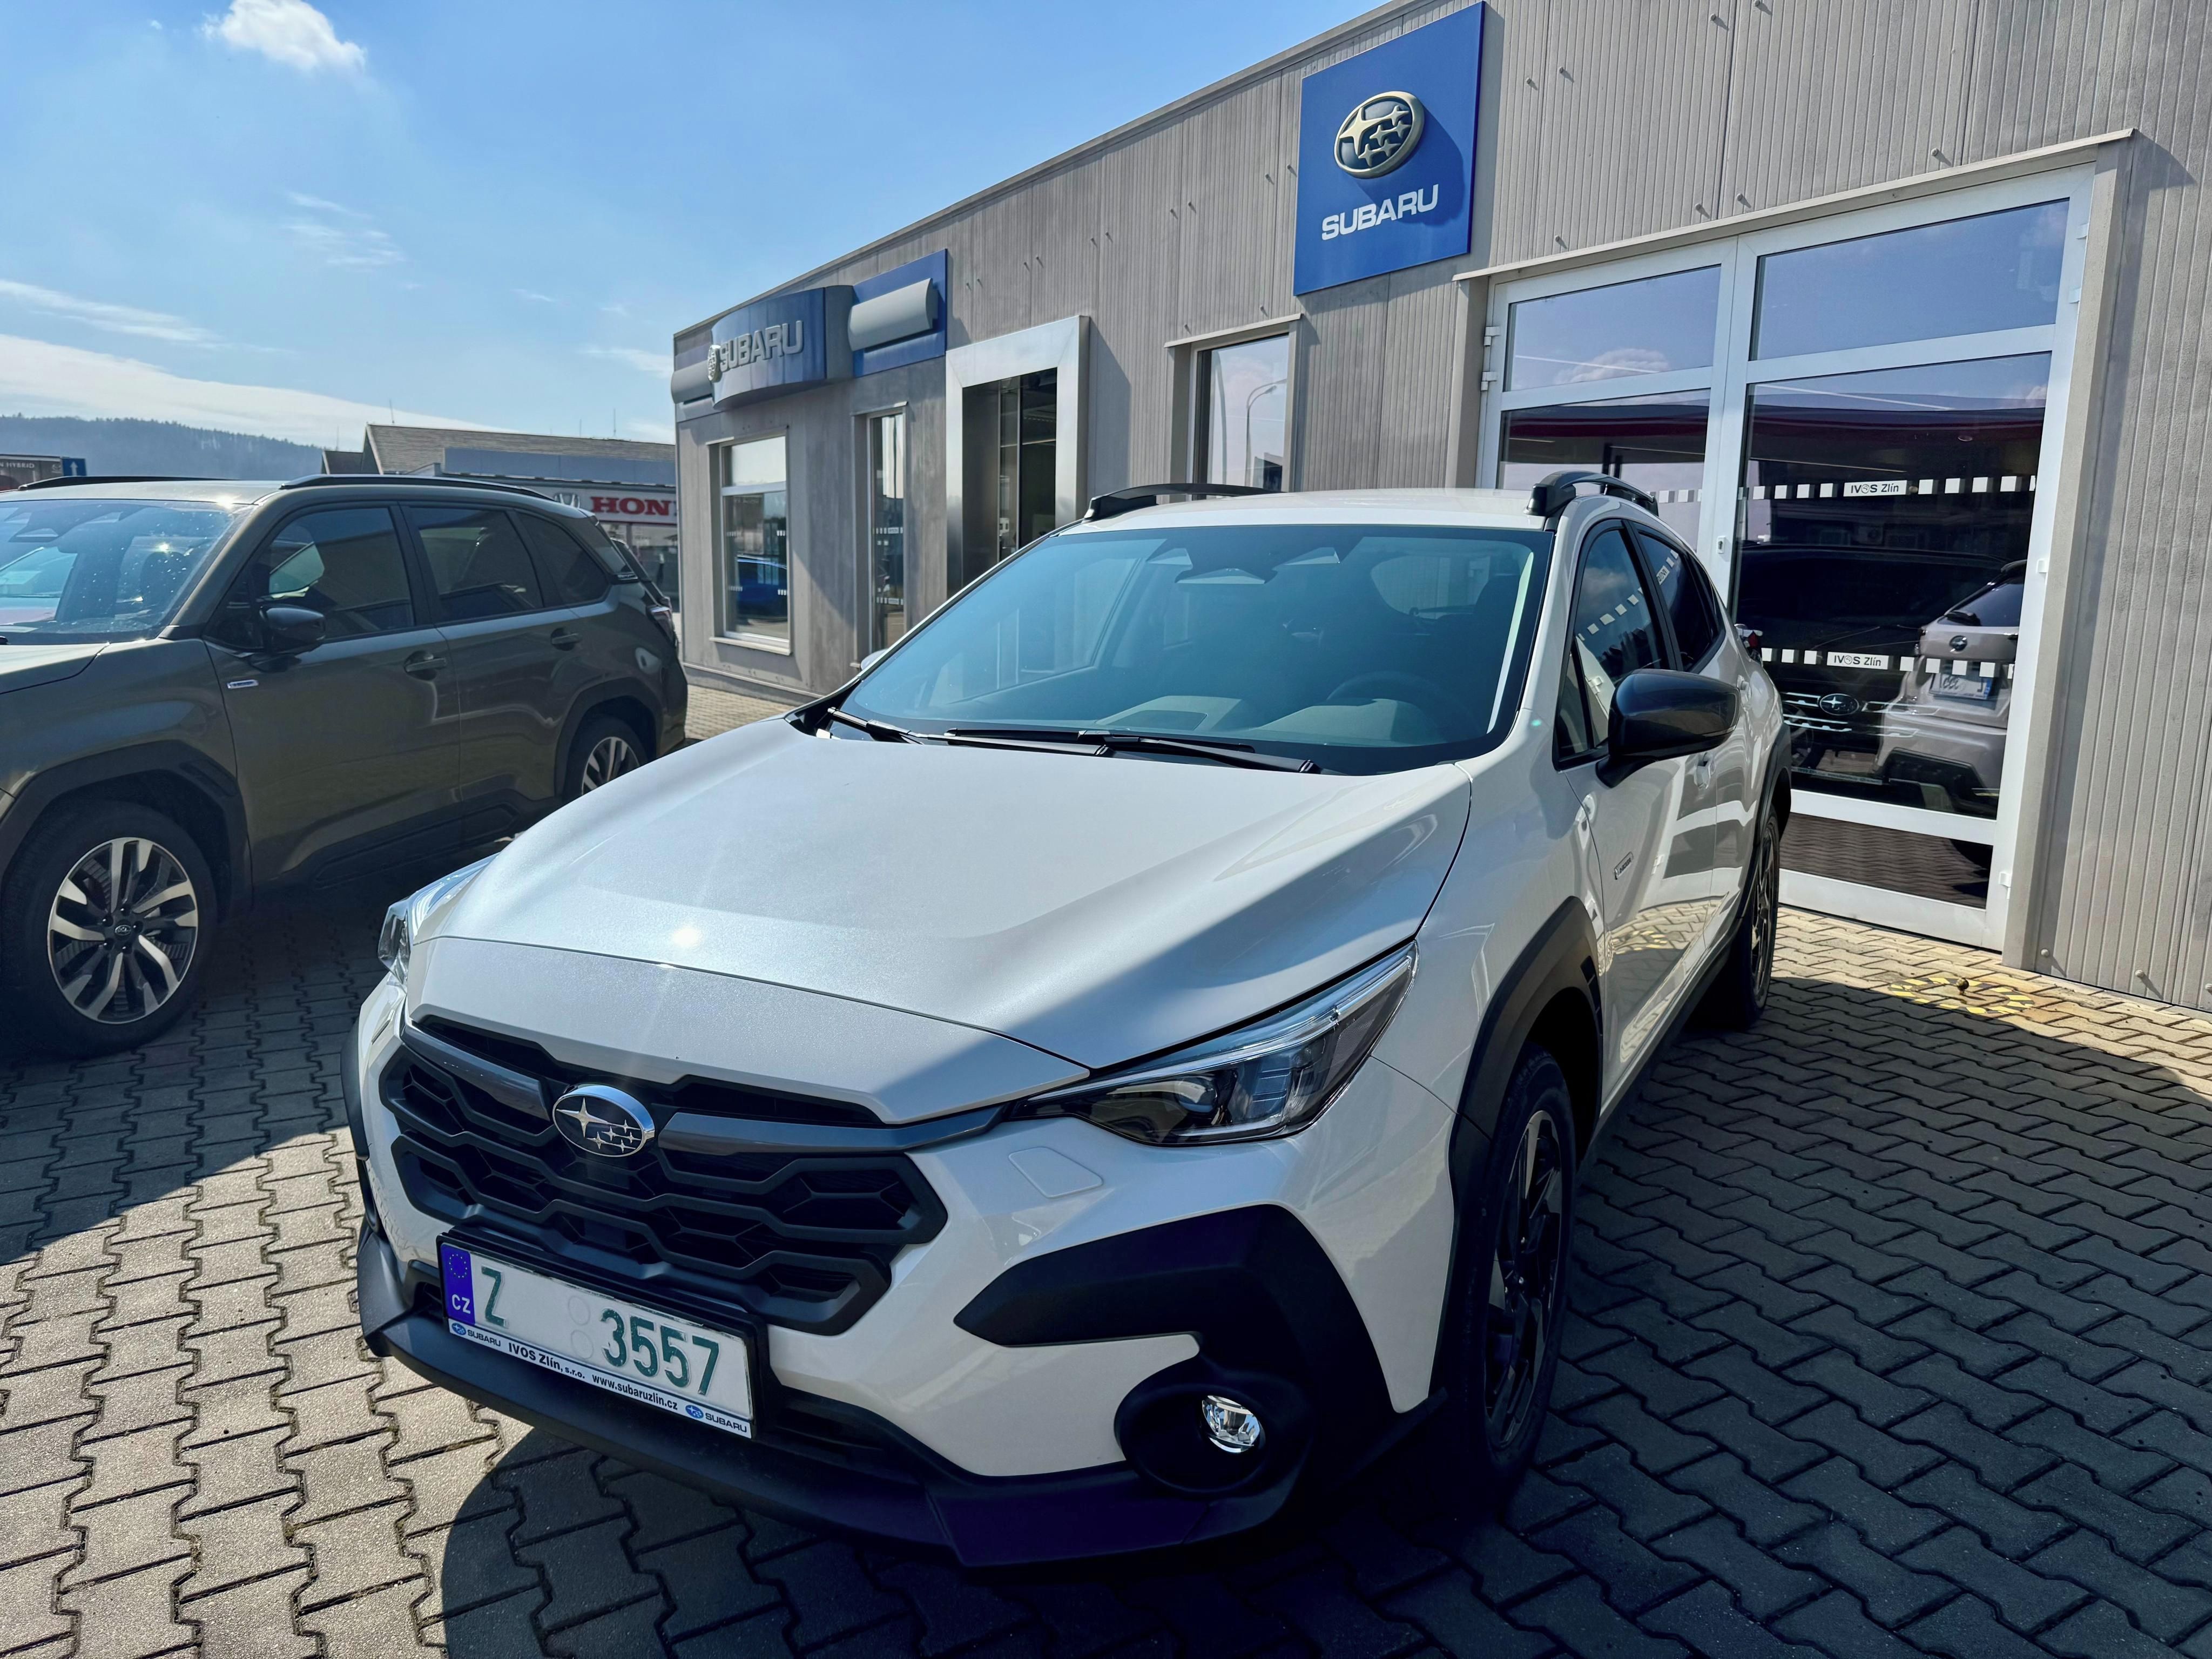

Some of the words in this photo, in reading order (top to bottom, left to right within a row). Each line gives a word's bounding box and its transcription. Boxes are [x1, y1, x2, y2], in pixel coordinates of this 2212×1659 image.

[1322, 184, 1439, 240] SUBARU
[719, 320, 804, 372] SUBARU
[590, 496, 677, 516] HON
[1881, 483, 1899, 493] Zlín
[1864, 657, 1881, 666] Zlín
[451, 1294, 471, 1314] CZ
[481, 1266, 507, 1327] Z
[600, 1308, 720, 1396] 3557
[468, 1329, 501, 1347] SUBARU
[509, 1342, 536, 1361] IVOS
[539, 1353, 563, 1372] Zlín,
[565, 1366, 585, 1379] s.r.o.
[592, 1374, 678, 1411] www.subaruzlin.cz
[705, 1413, 747, 1433] SUBARU
